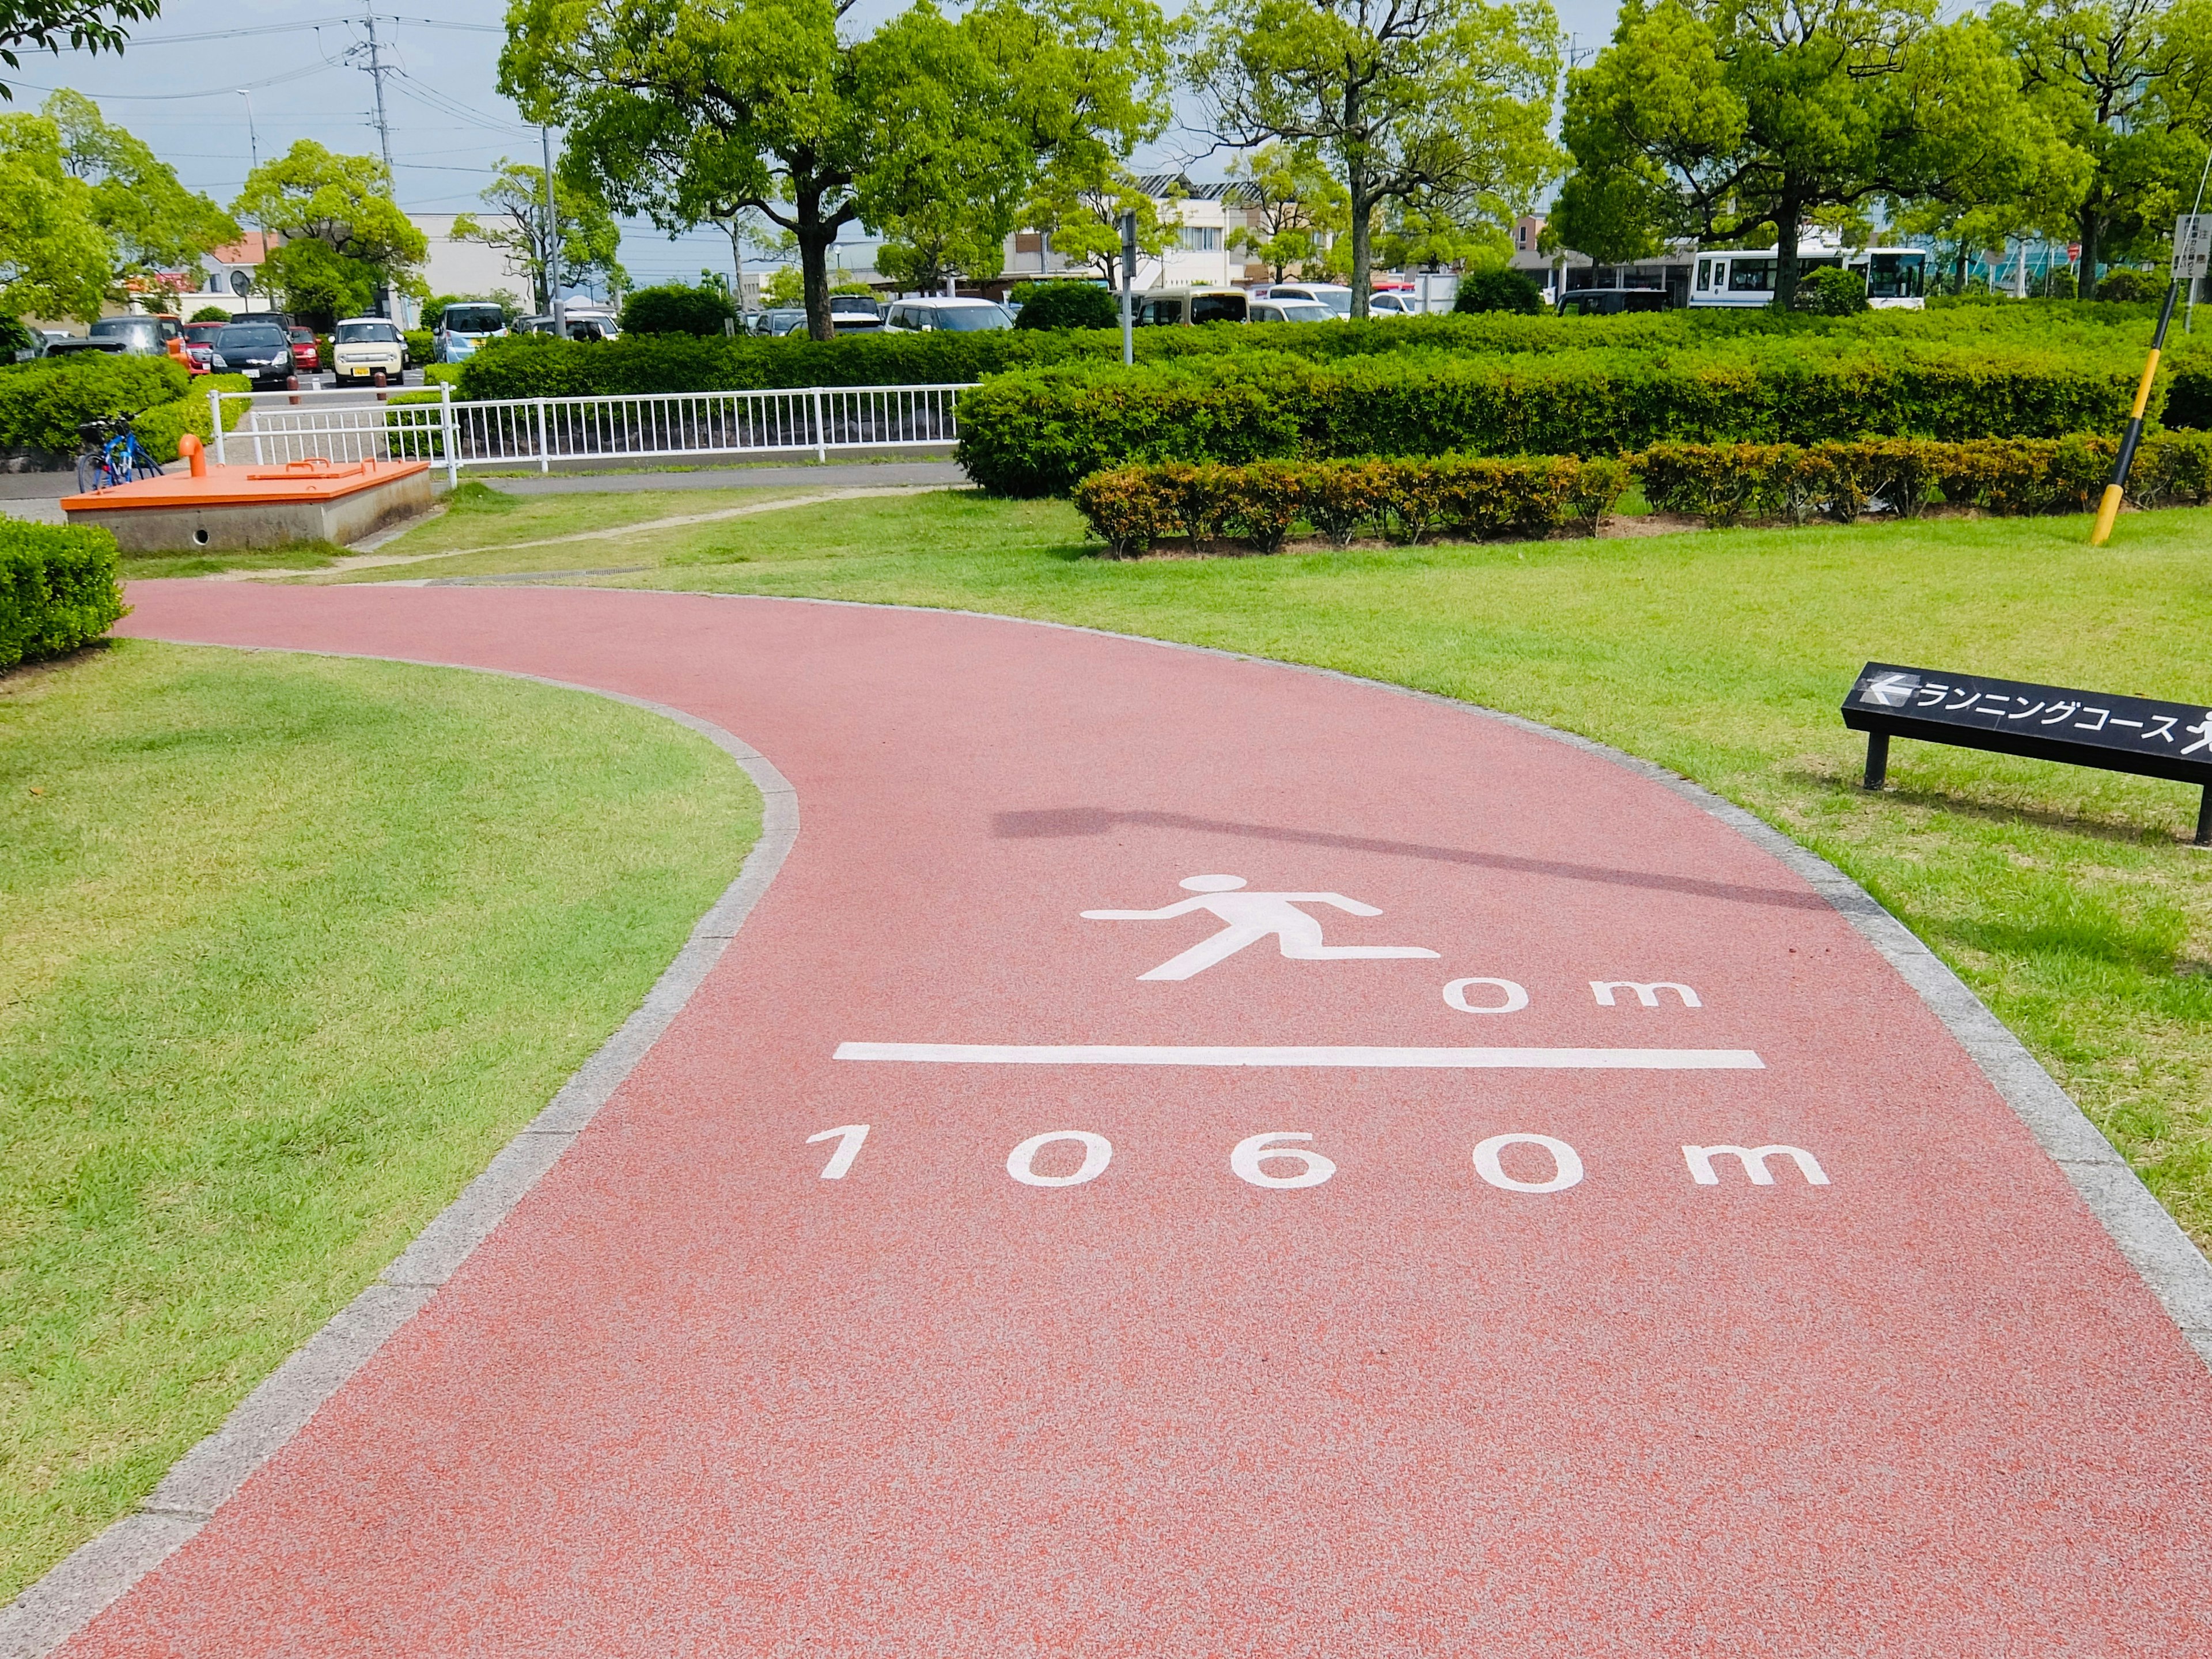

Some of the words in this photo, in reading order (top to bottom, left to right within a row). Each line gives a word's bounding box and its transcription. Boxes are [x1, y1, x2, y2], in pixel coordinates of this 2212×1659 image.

[1917, 683, 2179, 743] ランニングコース
